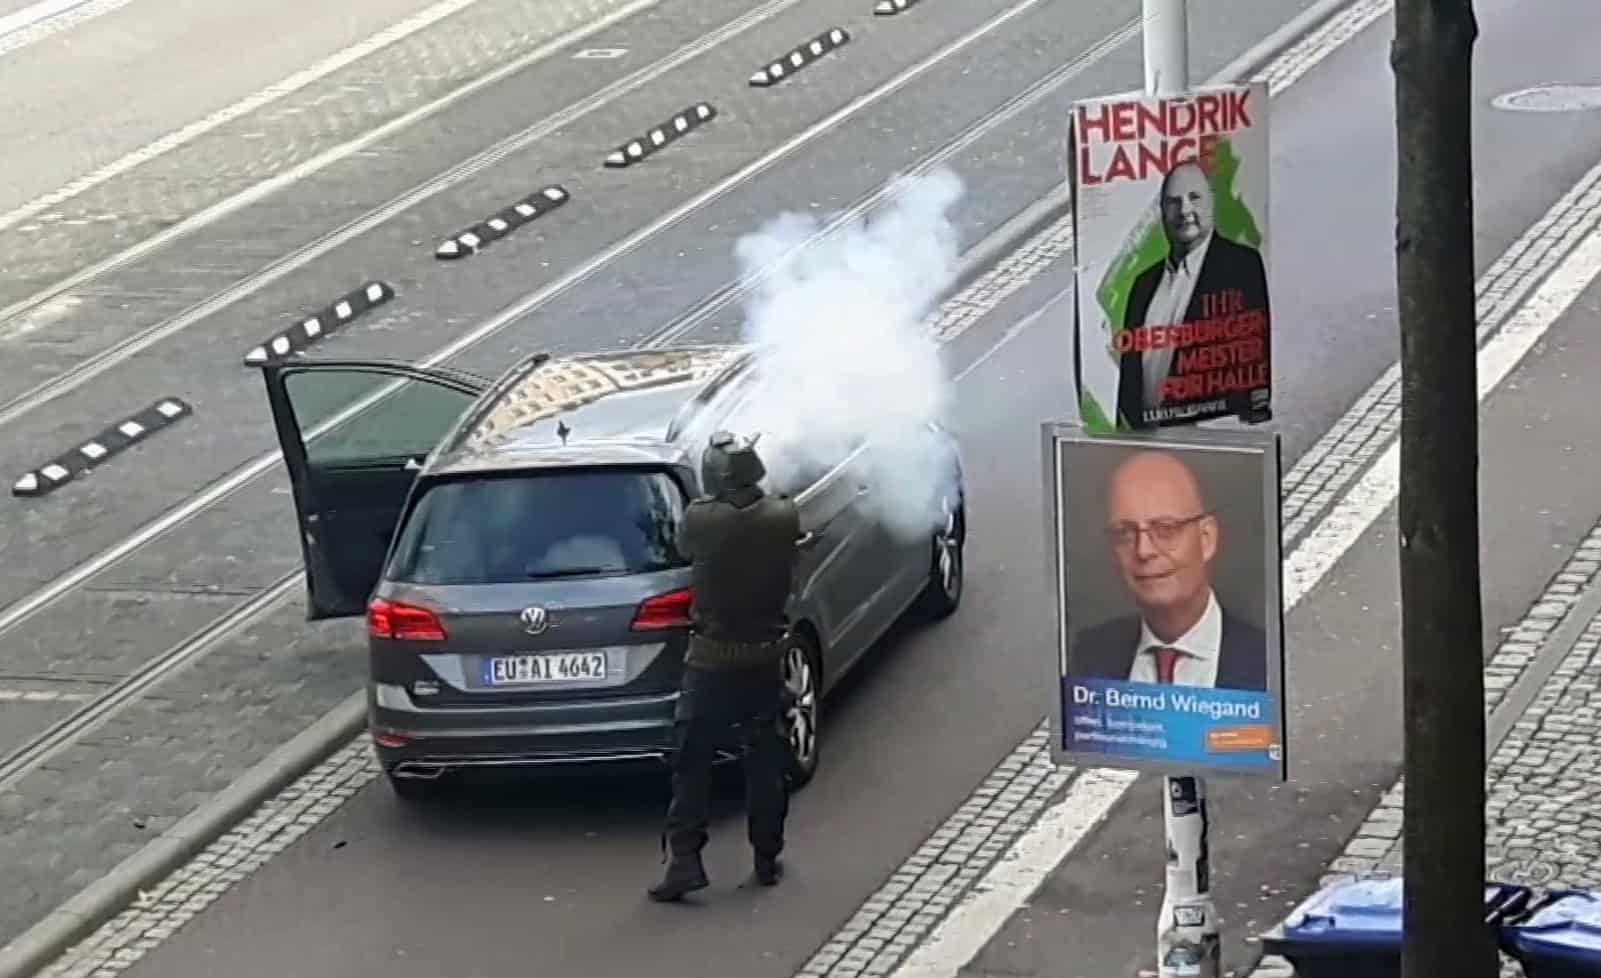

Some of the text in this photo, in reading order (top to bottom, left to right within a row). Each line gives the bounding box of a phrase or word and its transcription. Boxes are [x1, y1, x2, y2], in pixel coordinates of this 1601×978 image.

[1079, 90, 1251, 143] HENDRIK
[1081, 136, 1218, 185] LANGE
[494, 654, 603, 681] EU AI 4642
[1073, 686, 1261, 719] Dr. Bernd Wiegand
